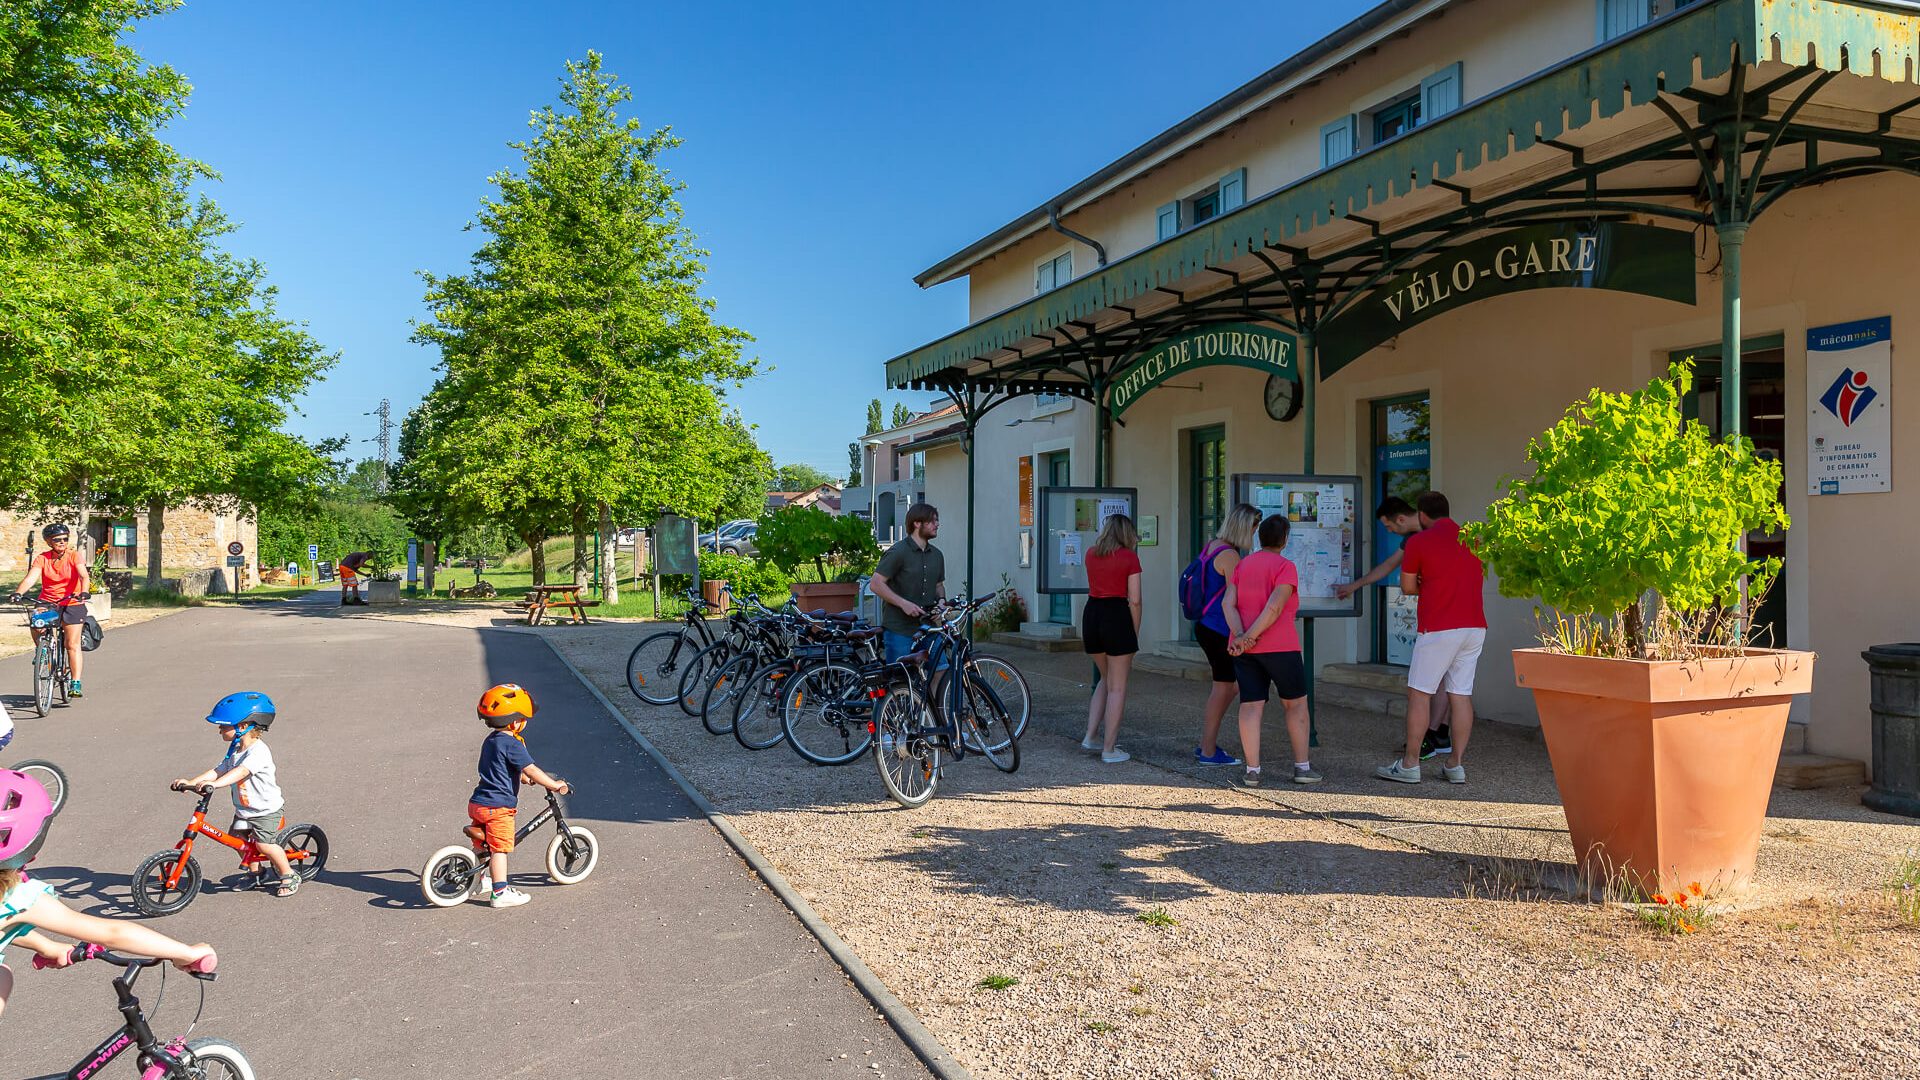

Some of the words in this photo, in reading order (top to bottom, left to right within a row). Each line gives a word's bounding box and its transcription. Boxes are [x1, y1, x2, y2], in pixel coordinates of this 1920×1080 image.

[1384, 237, 1597, 322] VÉLO-GARE
[1115, 352, 1166, 407] OFFICE
[1168, 339, 1191, 369] DE
[1194, 332, 1290, 368] TOURISME
[1834, 443, 1861, 451] BUREAU
[1389, 448, 1428, 459] Information
[1819, 452, 1877, 462] D'INFORMATIONS
[1837, 462, 1870, 471] CHARNAY
